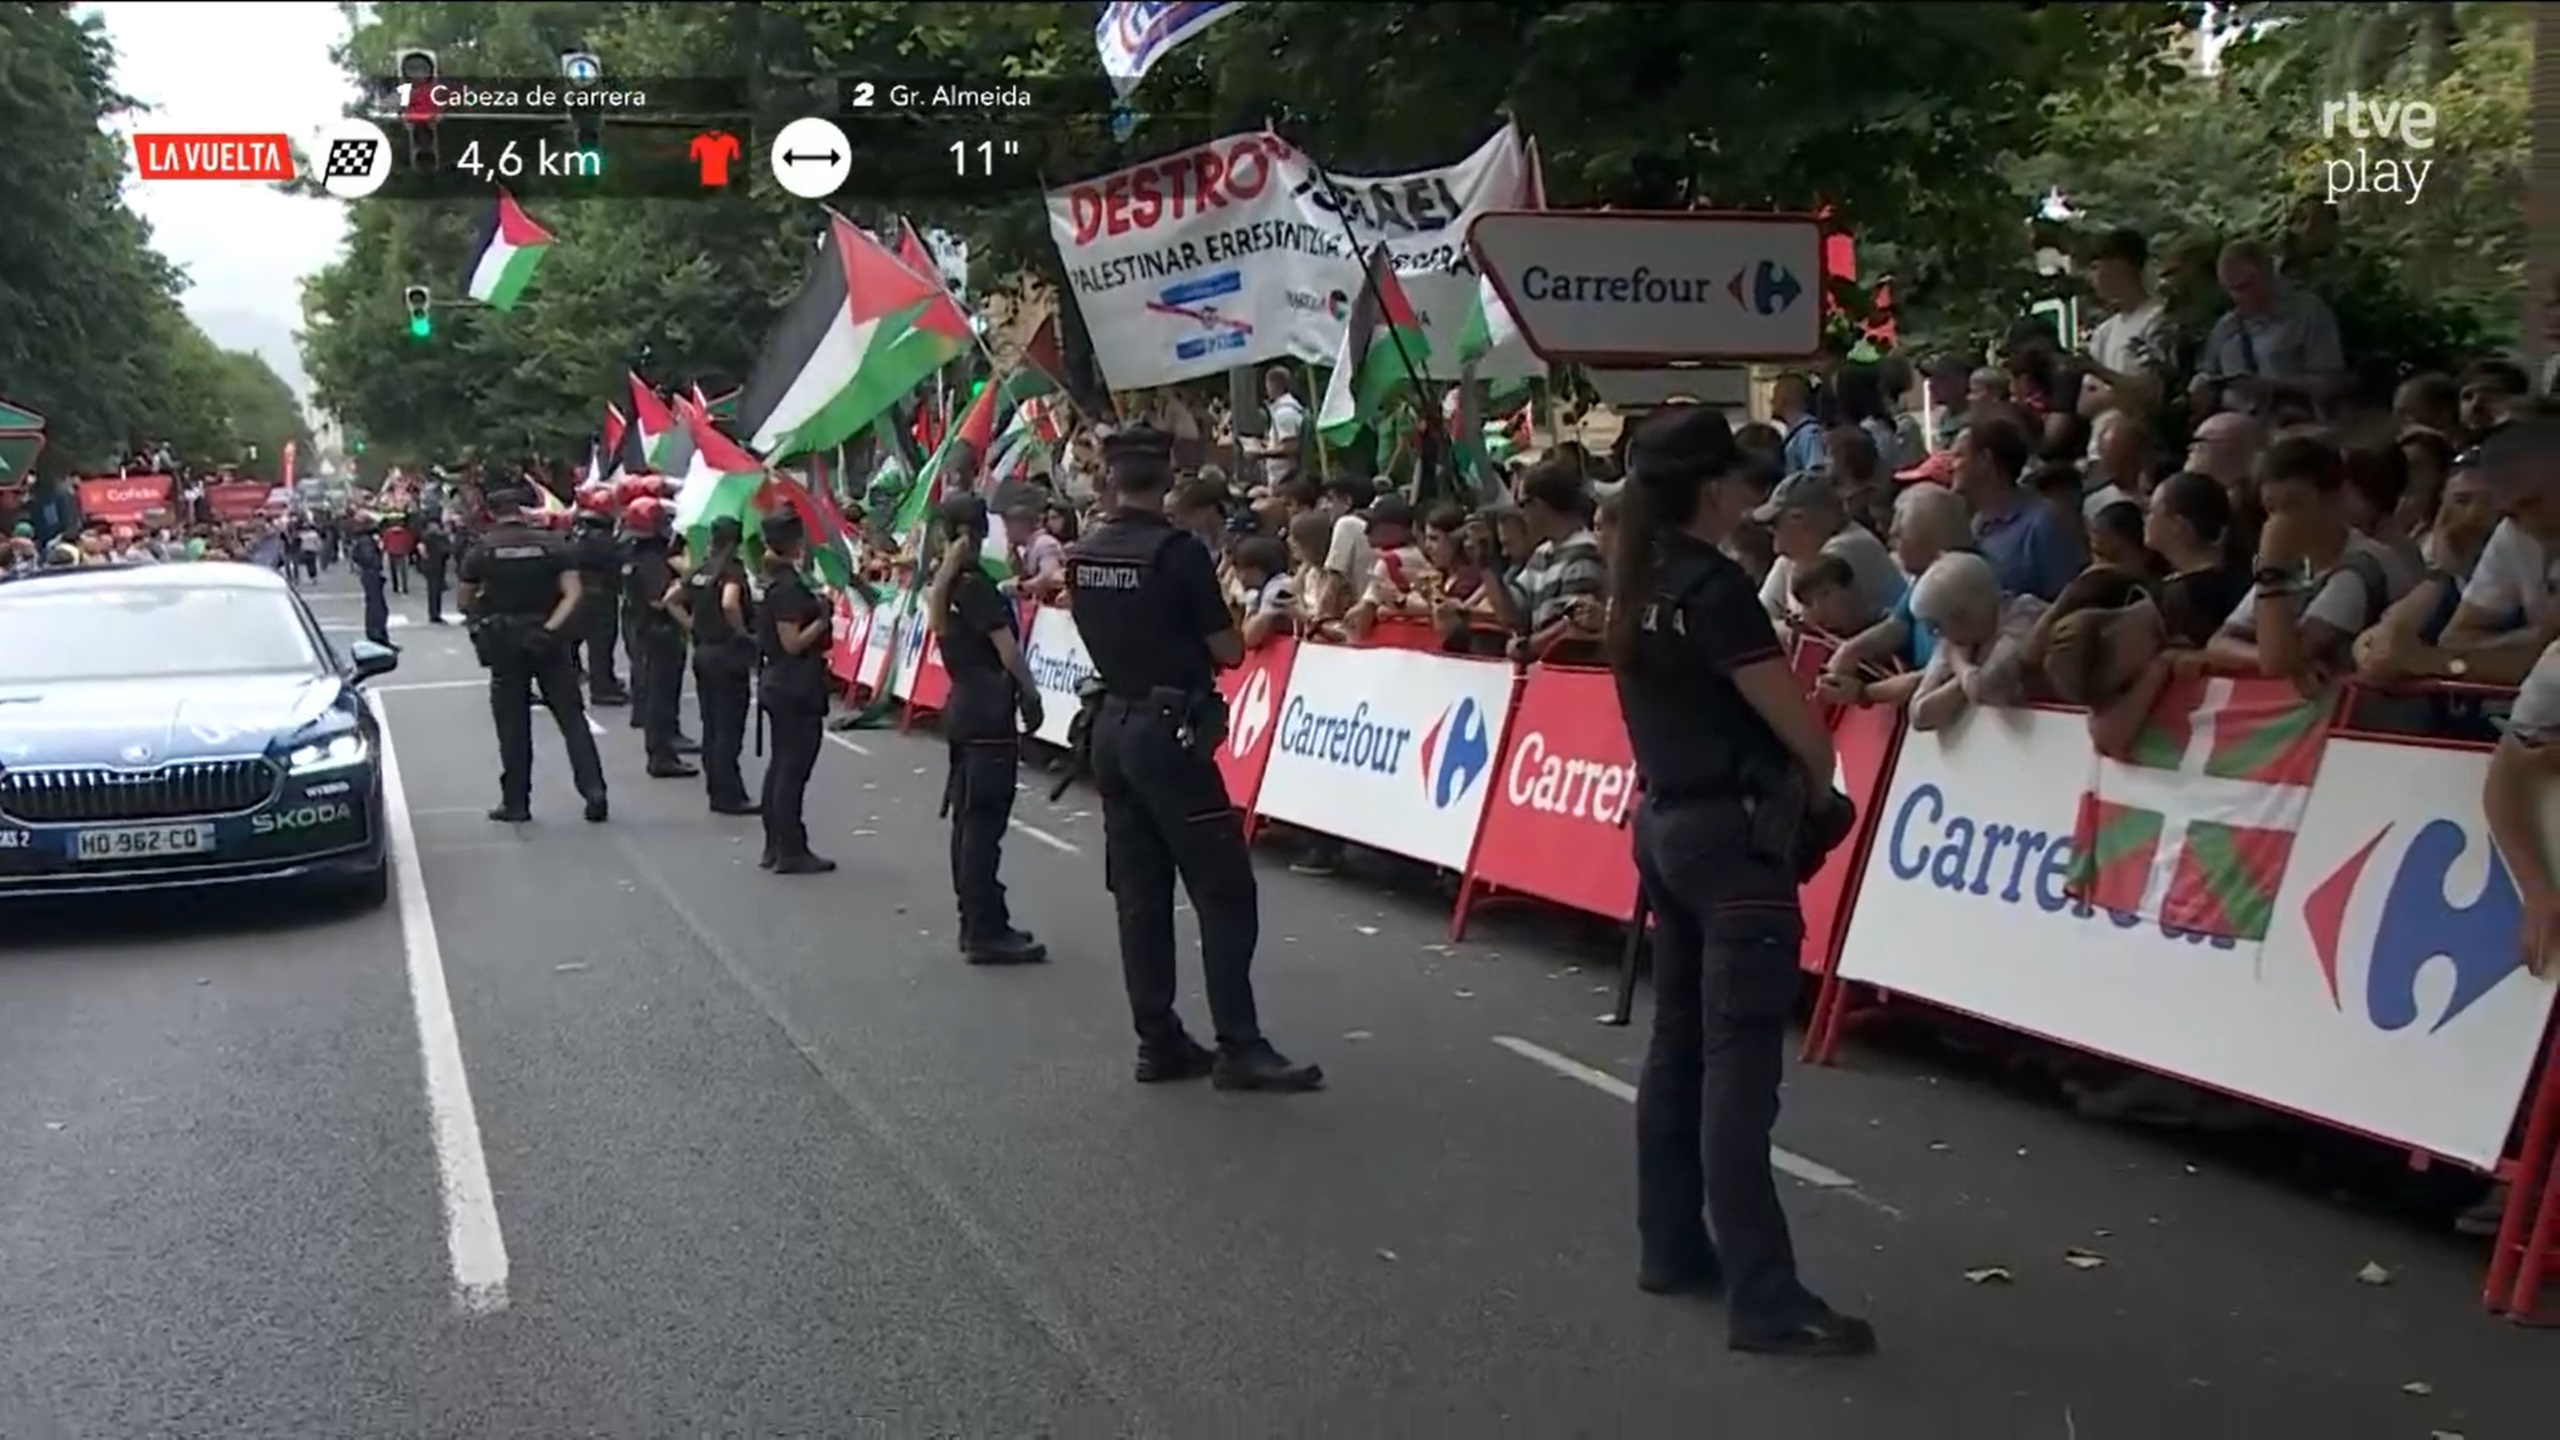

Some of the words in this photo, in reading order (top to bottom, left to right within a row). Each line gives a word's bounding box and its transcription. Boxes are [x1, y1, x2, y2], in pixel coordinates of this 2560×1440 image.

[1070, 137, 1291, 247] DESTRO
[1522, 265, 1711, 304] Carrefour
[1280, 695, 1410, 774] Carrefour
[1508, 732, 1638, 825] Carref
[1888, 784, 2237, 951] Carre
